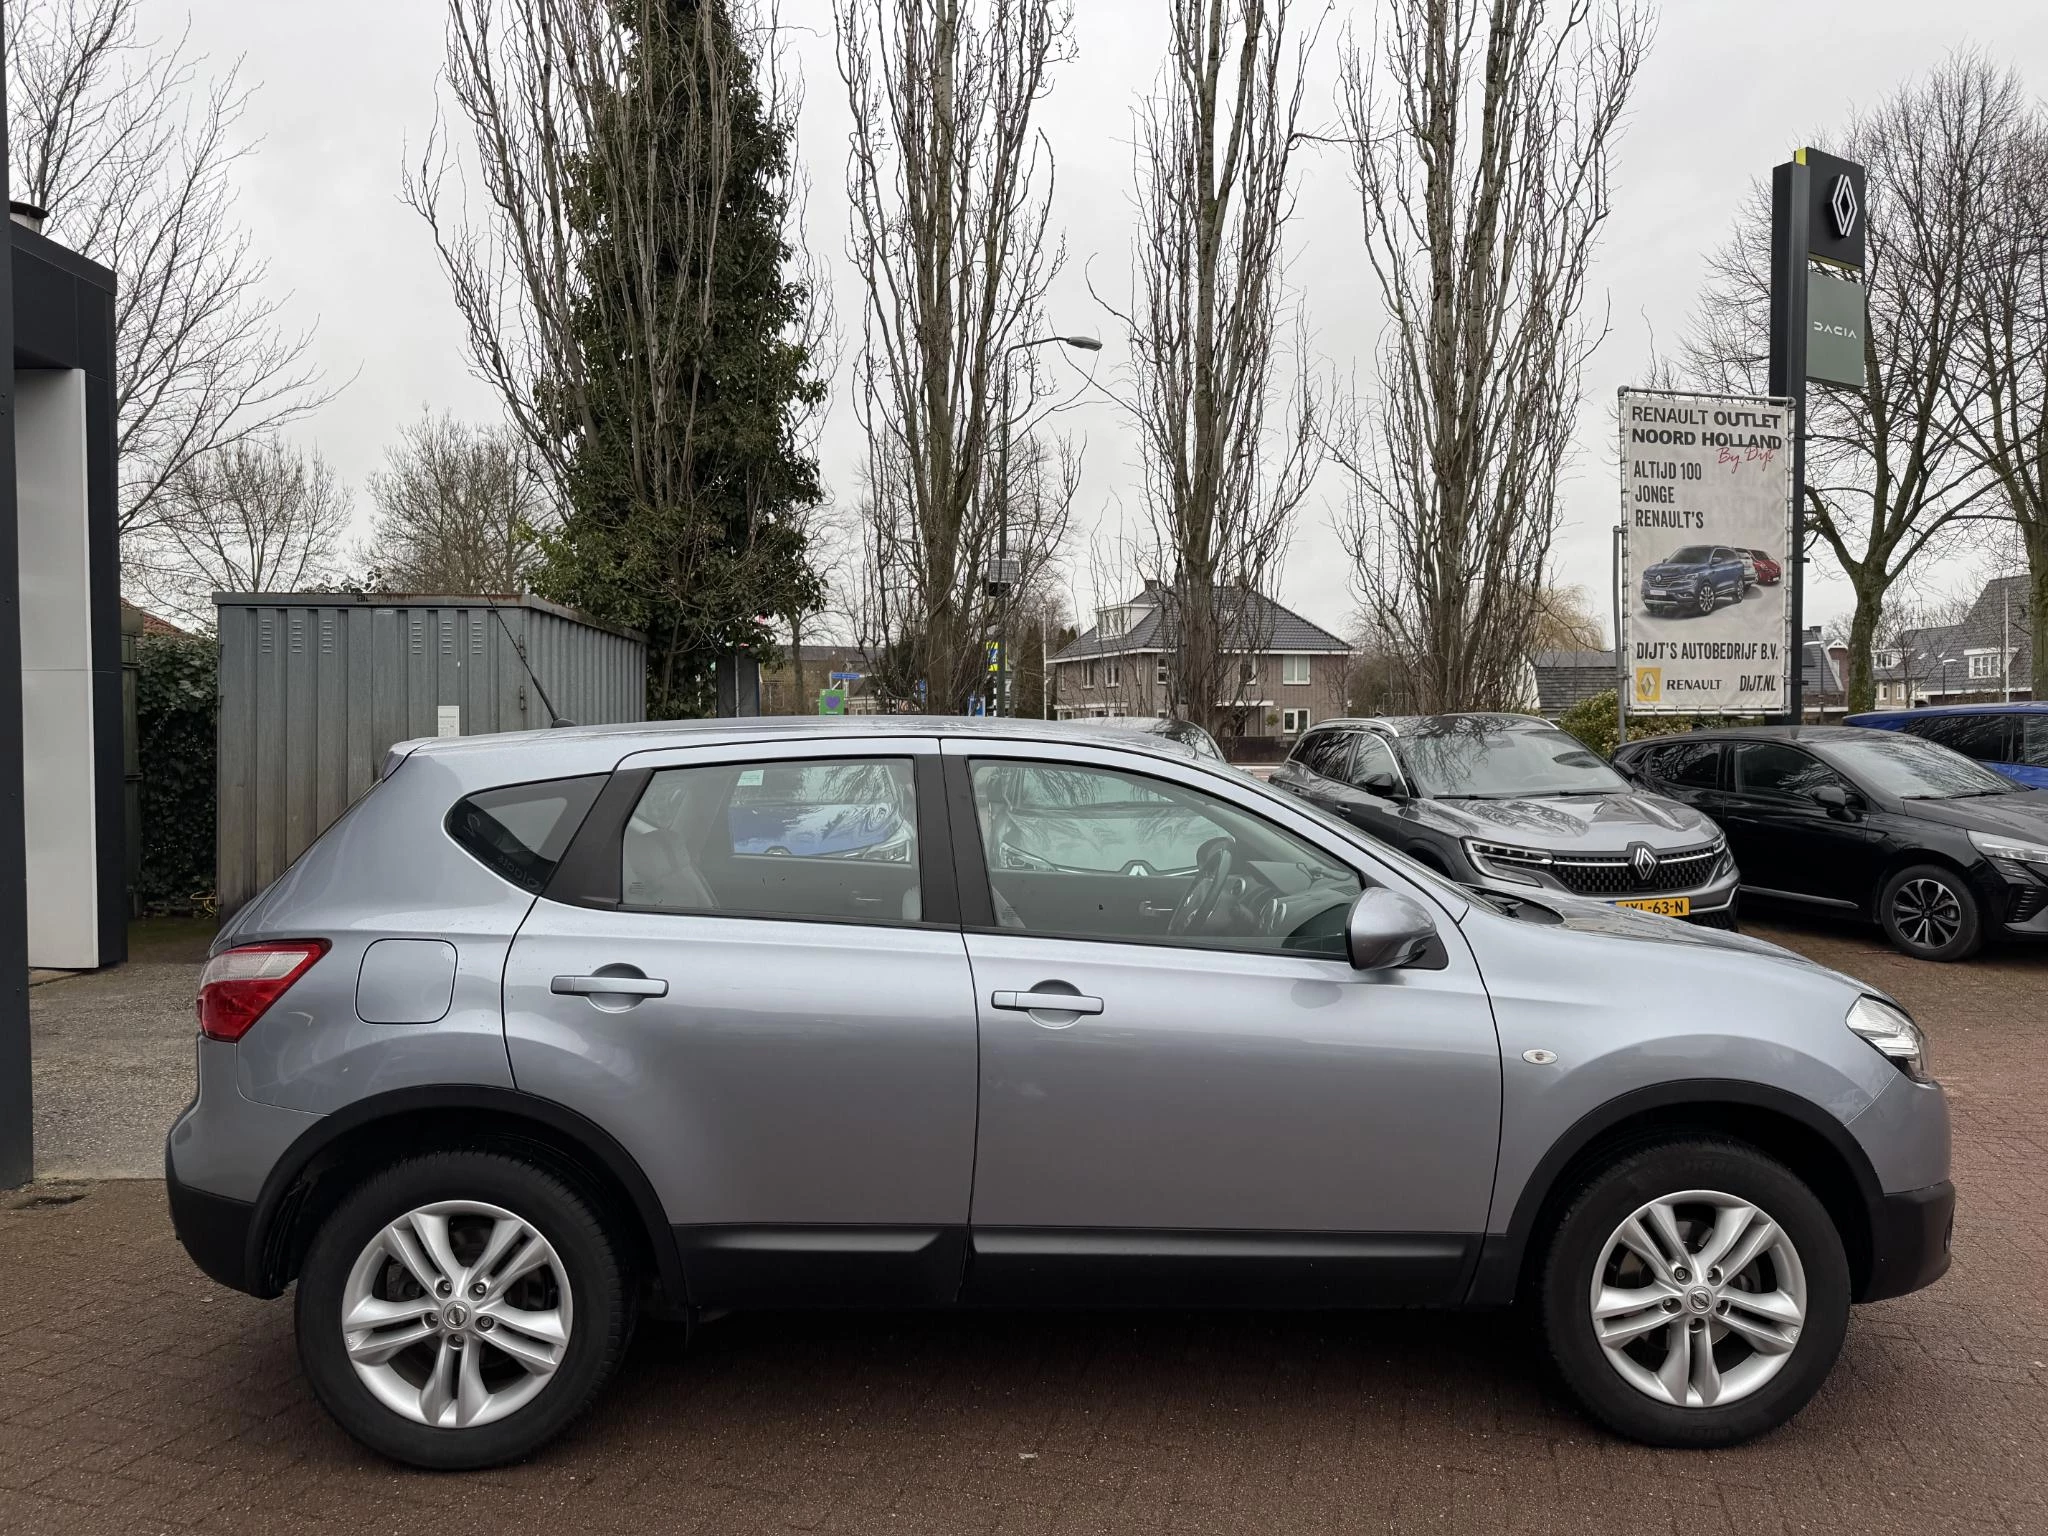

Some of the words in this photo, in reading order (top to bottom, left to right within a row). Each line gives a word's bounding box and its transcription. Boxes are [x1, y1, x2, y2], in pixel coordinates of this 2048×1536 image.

[1813, 321, 1857, 339] DACIA
[1632, 406, 1708, 425] RENAULT
[1714, 411, 1781, 429] OUTLET
[1632, 428, 1696, 445] NOORD
[1701, 432, 1782, 450] HOLLAND
[1716, 446, 1742, 473] By
[1633, 460, 1676, 480] ALTIJD
[1680, 462, 1702, 480] 100
[1635, 485, 1675, 504] JONGE
[1635, 510, 1704, 529] RENAULT'S
[1636, 642, 1677, 660] DIJT'S
[1681, 642, 1757, 660] AUTOBEDRIJF
[1761, 643, 1778, 660] B.V.
[1666, 679, 1722, 691] RENAULT
[1740, 675, 1776, 692] DIJT.NL
[1626, 900, 1684, 914] -63-N
